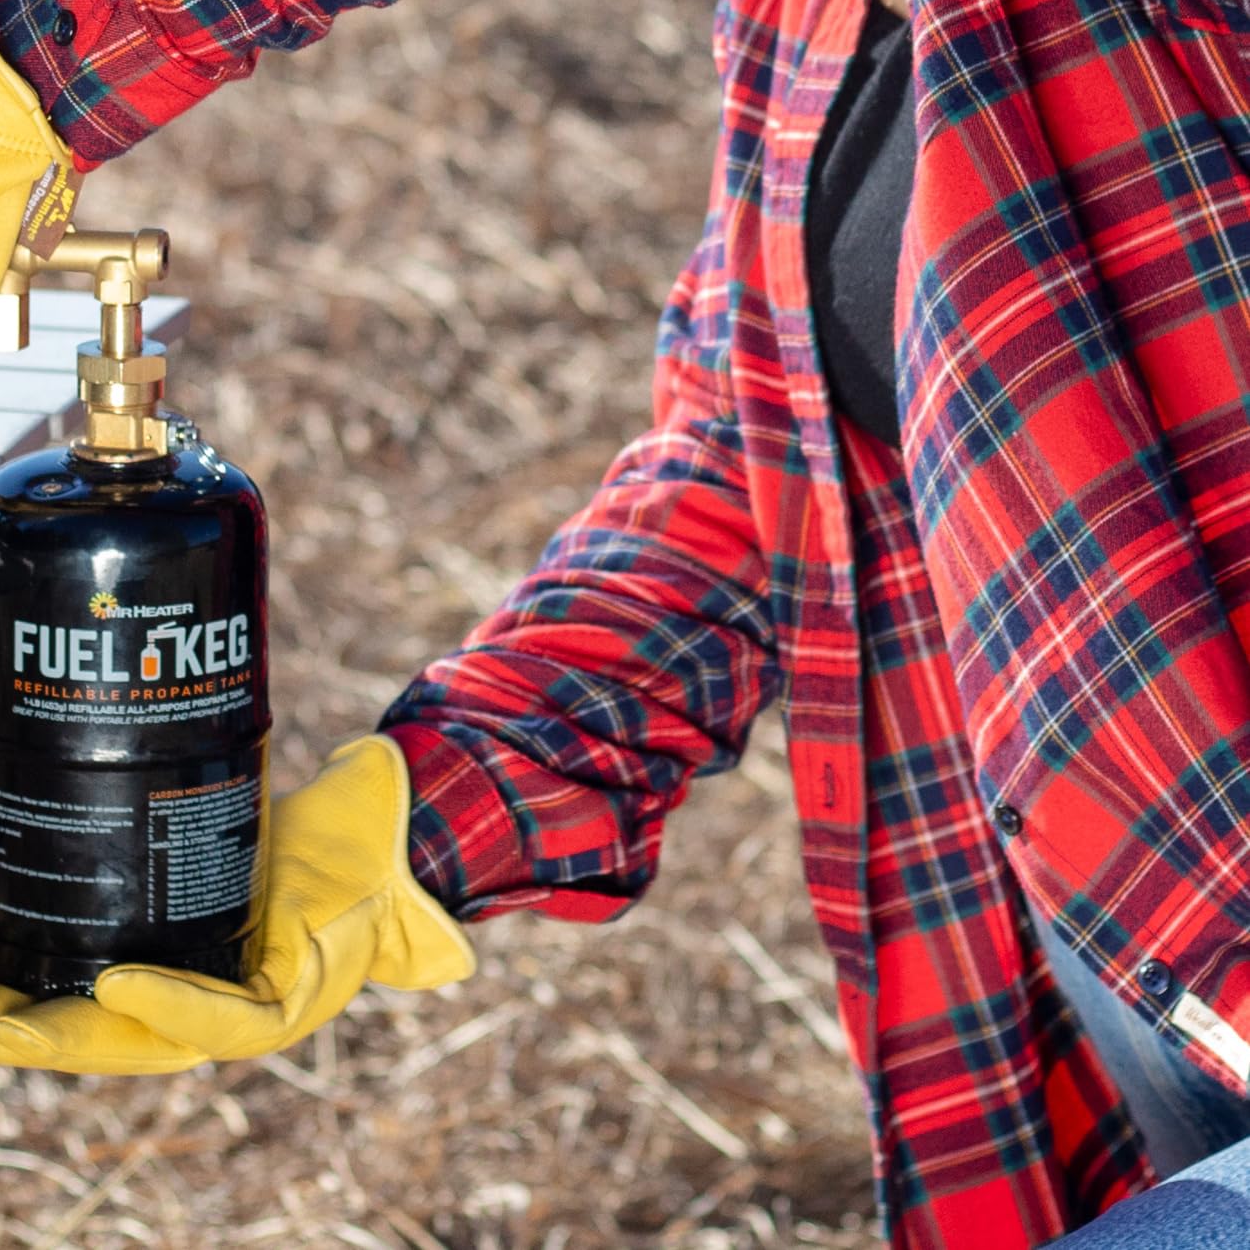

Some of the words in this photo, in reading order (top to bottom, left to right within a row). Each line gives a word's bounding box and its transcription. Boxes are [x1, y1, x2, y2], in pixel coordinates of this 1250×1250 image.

[133, 603, 194, 618] HEATER
[13, 619, 130, 682] FUEL
[175, 613, 249, 679] KEG
[14, 678, 121, 701] REFILLABLE
[130, 681, 215, 700] PROPANE
[221, 670, 251, 688] TANK
[68, 703, 125, 715] REFILLABLE
[126, 701, 190, 715] ALL-PURPOSE
[192, 694, 227, 708] PROPANE
[35, 710, 50, 719] FOR
[51, 712, 67, 722] USE
[68, 714, 89, 723] WITH
[90, 716, 131, 724] PORTABLE
[133, 714, 170, 724] HEATERS
[171, 711, 189, 721] AND
